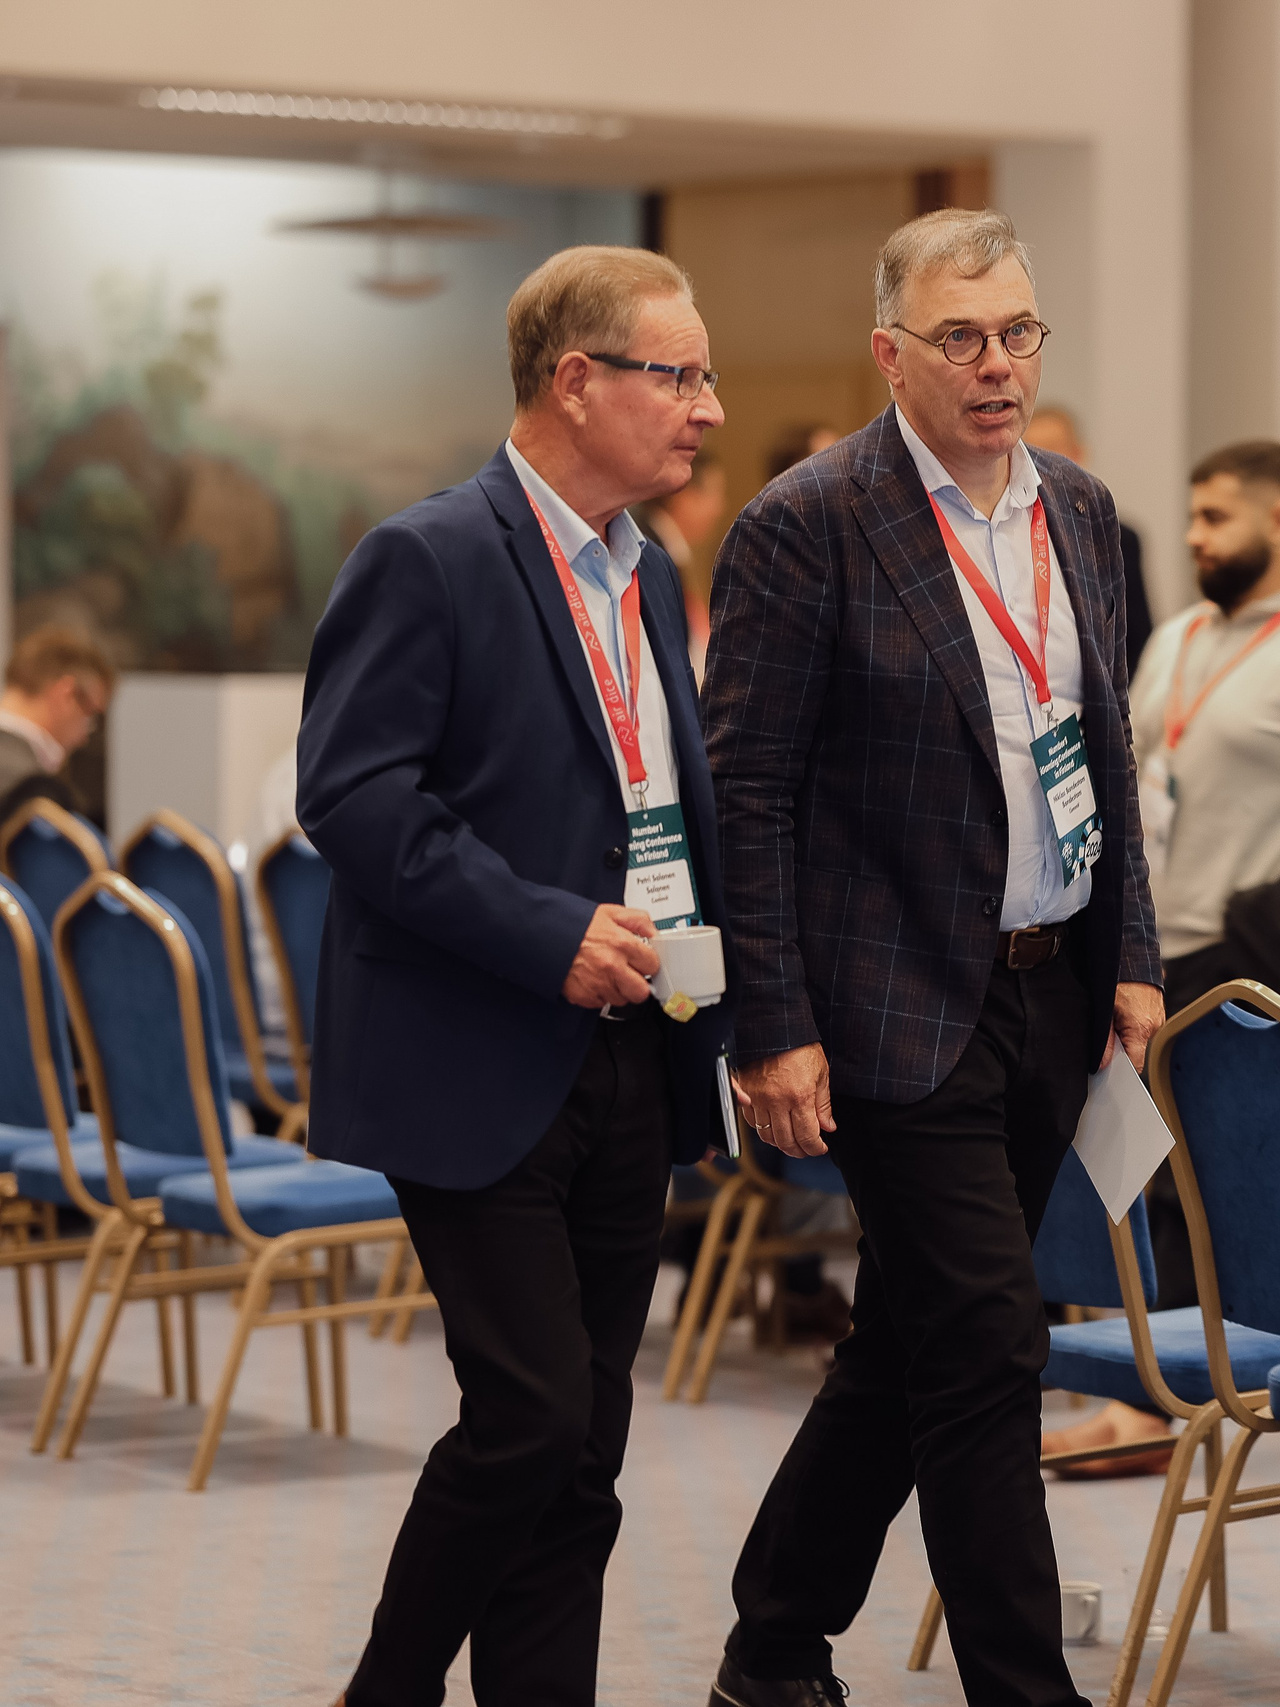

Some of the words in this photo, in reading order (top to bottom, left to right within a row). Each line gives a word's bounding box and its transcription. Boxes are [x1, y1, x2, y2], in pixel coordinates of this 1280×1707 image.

[1036, 543, 1046, 559] air
[567, 584, 582, 609] dice
[577, 610, 591, 627] air
[604, 678, 619, 704] dice
[612, 706, 626, 722] air
[632, 824, 658, 837] Number
[646, 834, 682, 848] Conference
[644, 848, 669, 861] Finland
